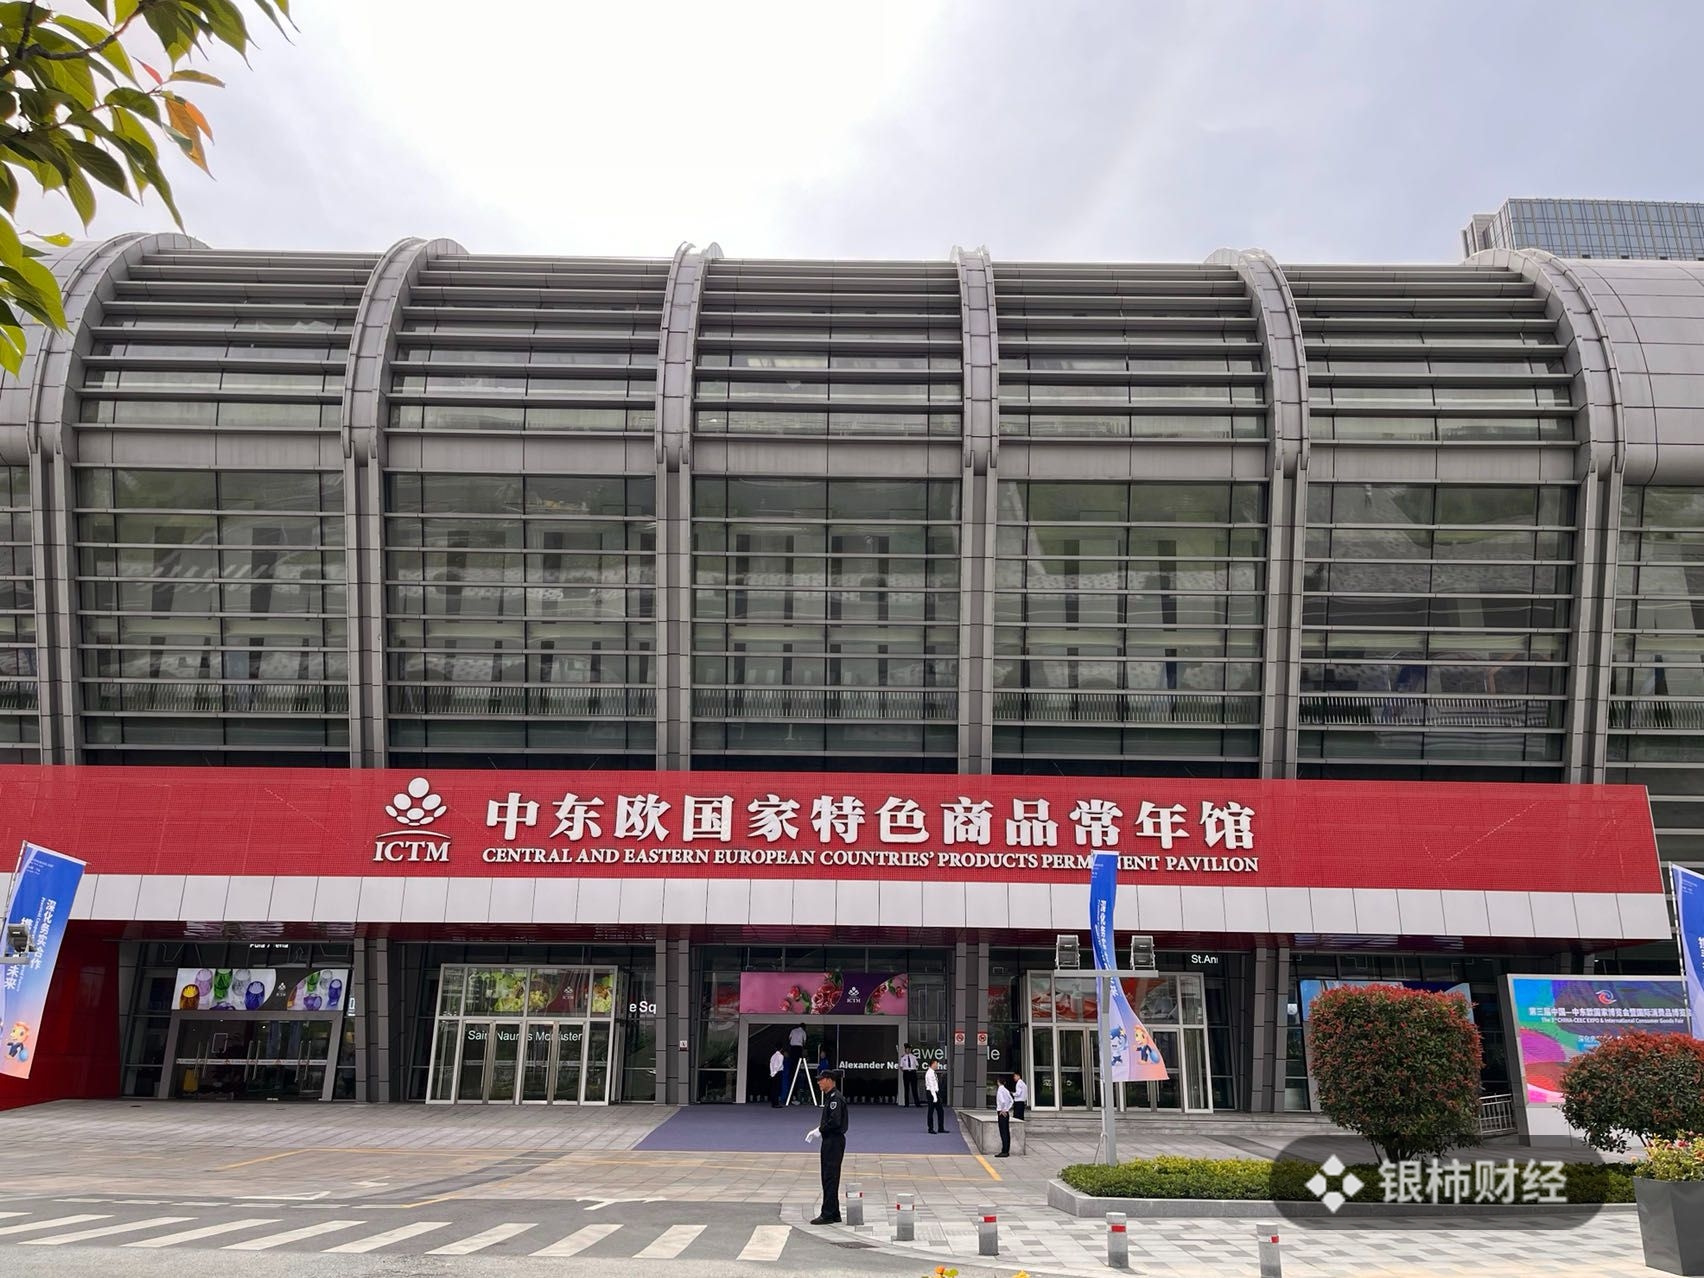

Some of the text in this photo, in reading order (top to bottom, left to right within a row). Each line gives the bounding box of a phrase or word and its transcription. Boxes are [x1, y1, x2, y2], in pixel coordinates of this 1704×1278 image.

[486, 792, 1255, 850] 中东欧国家特色商品常年馆
[373, 840, 451, 862] ICTM
[482, 848, 573, 863] CENTRAL
[575, 848, 620, 863] AND
[622, 848, 710, 864] EASTERN
[713, 849, 816, 865] EUROPEAN
[937, 853, 1038, 868] PRODUCTS
[1041, 855, 1160, 872] PERMNENT
[1164, 856, 1259, 873] PAVILION
[838, 1060, 885, 1069] Alexander
